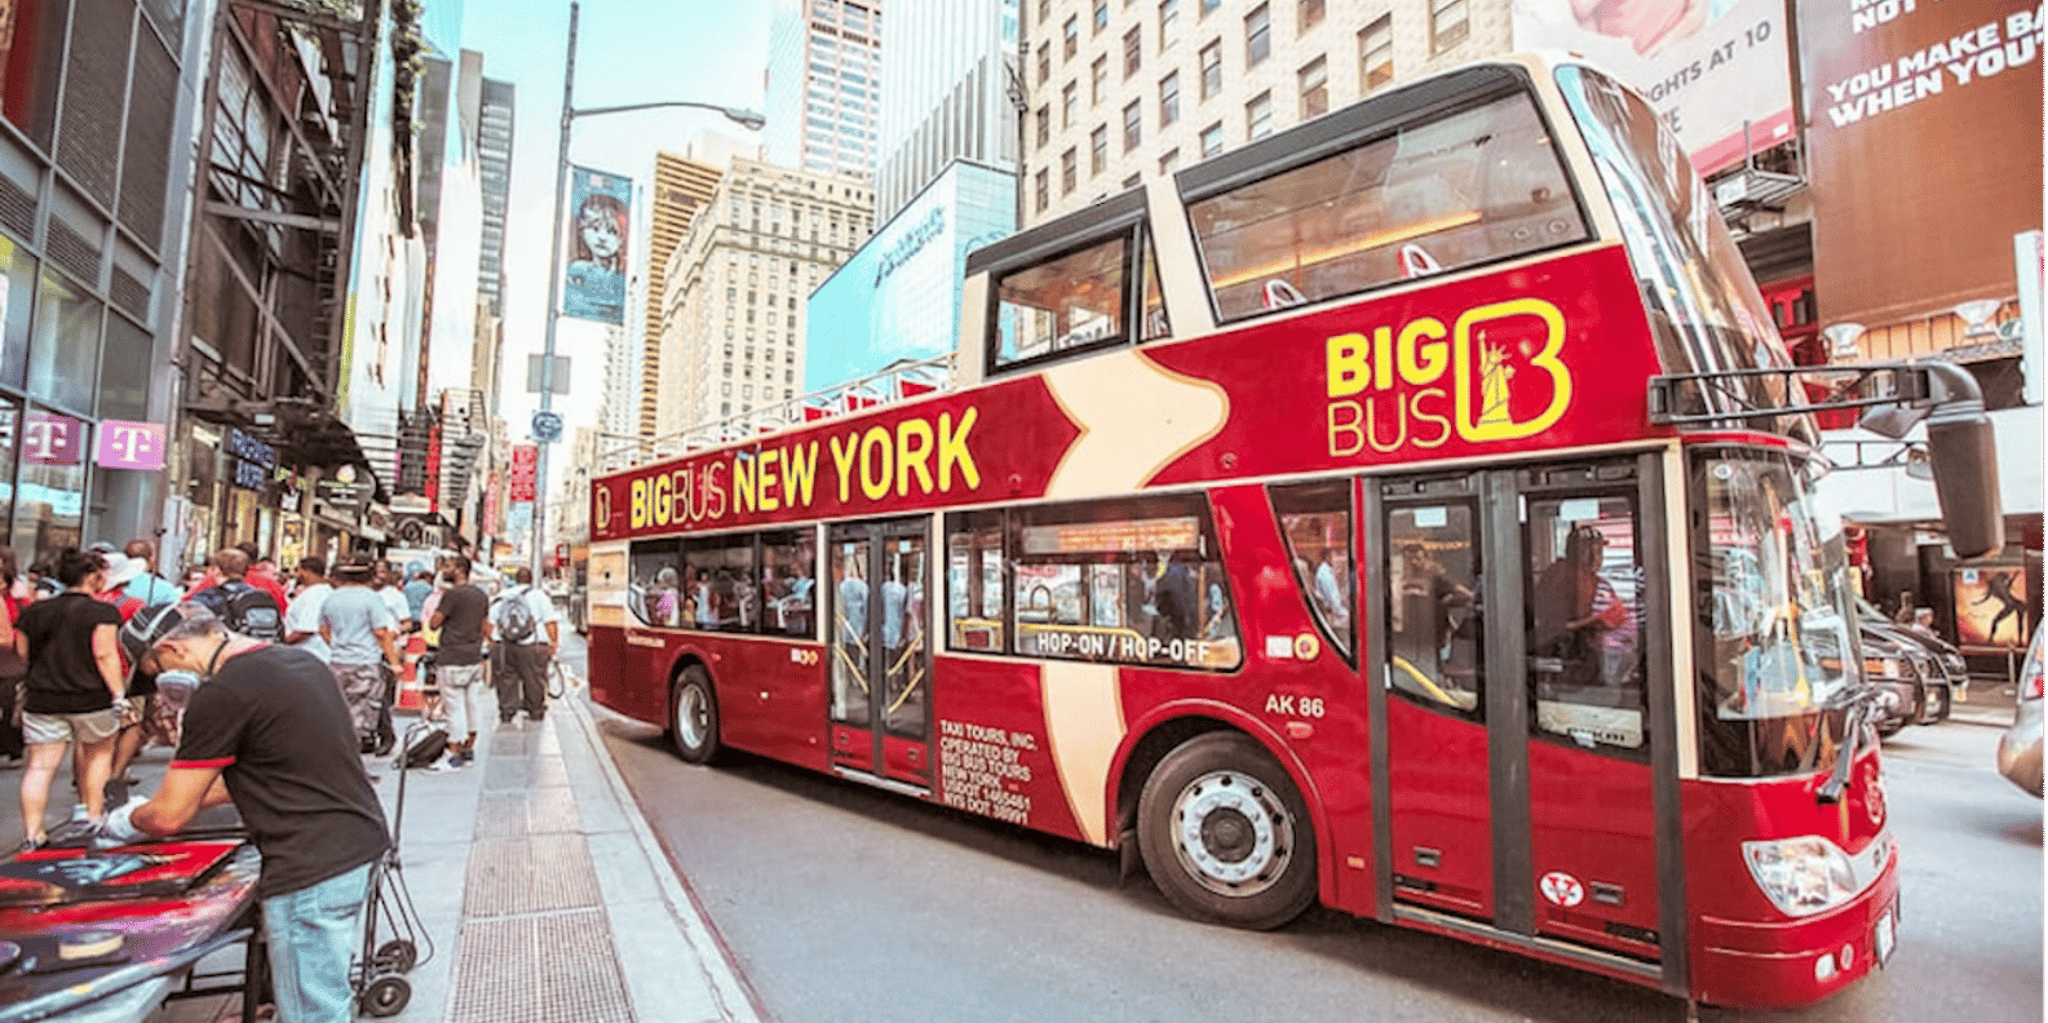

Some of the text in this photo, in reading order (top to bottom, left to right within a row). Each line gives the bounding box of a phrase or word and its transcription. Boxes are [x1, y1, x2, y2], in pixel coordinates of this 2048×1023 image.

[1645, 20, 1771, 102] GHTS AT 10
[1827, 63, 1892, 103] YOU
[1898, 22, 2001, 78] MAKE
[1828, 68, 1943, 128] WHEN
[1327, 316, 1449, 398] BIG
[1327, 387, 1452, 457] BUS
[732, 438, 820, 515] NEW
[829, 405, 982, 503] YORK
[1037, 632, 1102, 656] HOP-ON
[1119, 635, 1210, 663] HOP-OFF
[1264, 693, 1325, 719] AK 86
[940, 718, 965, 737] TAXI
[940, 736, 1020, 764] OPERATED BY
[941, 750, 1032, 783] BIG BUS TOURS
[942, 764, 1002, 790] NEW YORK
[967, 796, 991, 816] DOT
